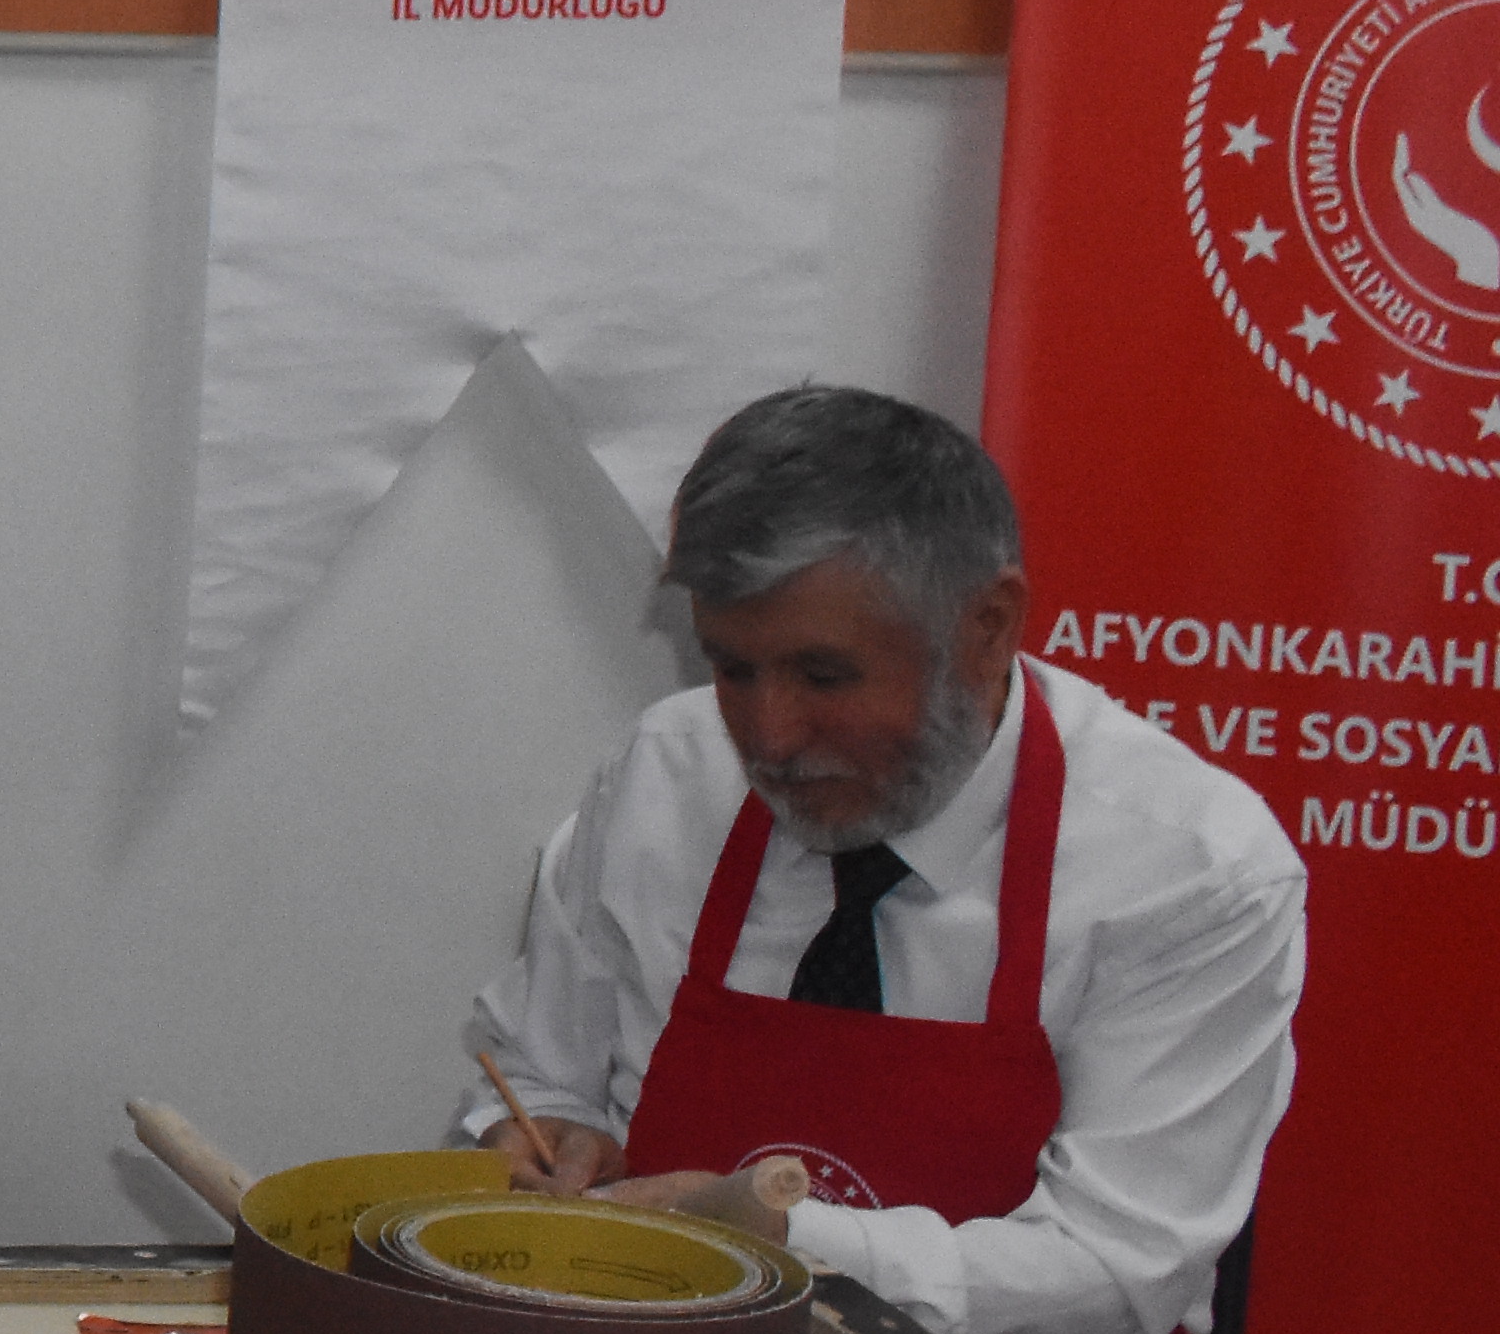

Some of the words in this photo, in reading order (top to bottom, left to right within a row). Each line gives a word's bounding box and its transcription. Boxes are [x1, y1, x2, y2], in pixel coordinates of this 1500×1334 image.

[1332, 235, 1449, 351] TÜRKİYE
[1198, 704, 1278, 757] VE
[1298, 711, 1500, 777] SOSYA
[1301, 790, 1497, 859] MÜDÜ
